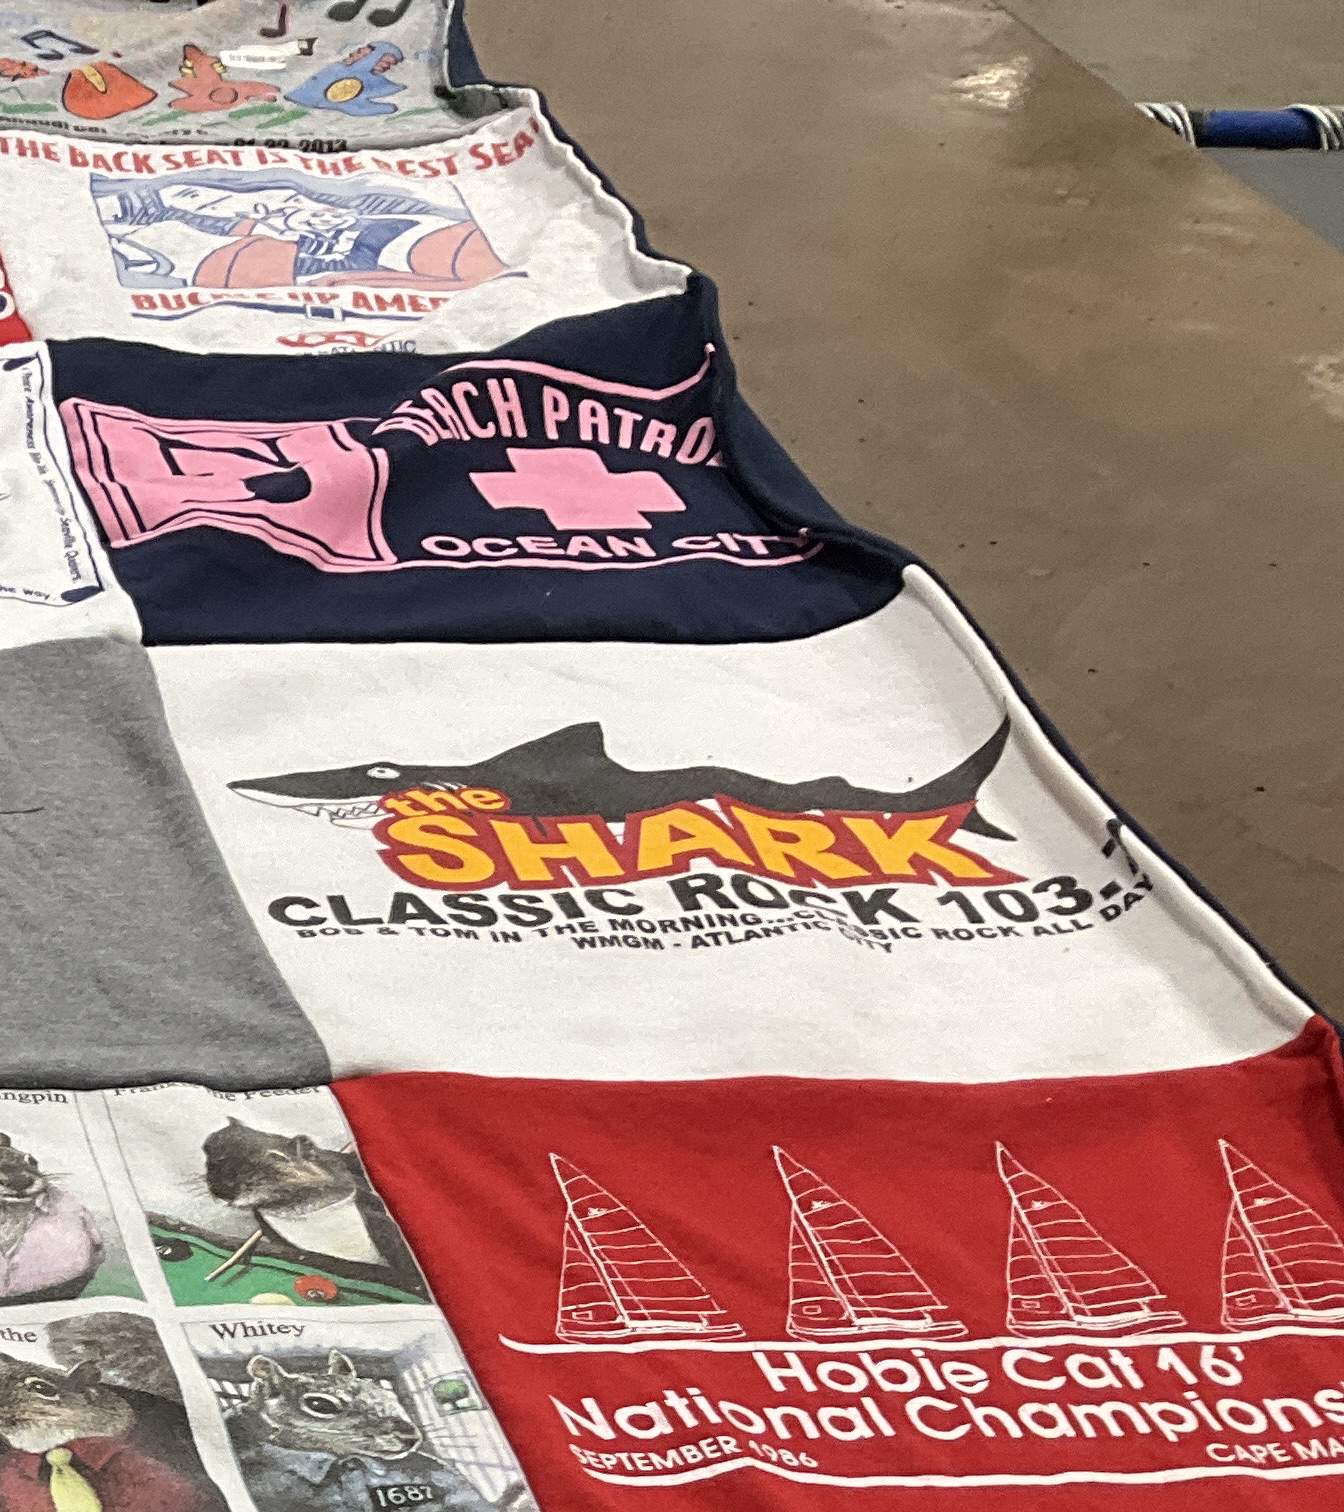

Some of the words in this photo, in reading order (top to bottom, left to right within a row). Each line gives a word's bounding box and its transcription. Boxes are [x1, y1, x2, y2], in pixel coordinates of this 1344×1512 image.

[67, 143, 157, 175] BACK
[161, 148, 244, 172] SEAT
[468, 118, 541, 171] SEA
[371, 377, 528, 447] BEACH
[542, 384, 725, 467] PATRO
[420, 534, 656, 558] OCEAN
[384, 786, 509, 818] the
[383, 802, 997, 886] SHARK
[267, 887, 644, 928] CLASSIC
[666, 872, 921, 926] ROCK
[295, 926, 366, 939] BOB
[408, 926, 481, 941] TOM
[490, 930, 523, 943] IN
[532, 920, 600, 938] THE
[931, 925, 1024, 942] ROCK
[1032, 919, 1094, 937] ALL
[1098, 873, 1154, 922] DAY
[570, 936, 664, 951] WMGM
[689, 921, 832, 950] ATLANTIC
[209, 1321, 308, 1341] Whitey
[753, 1347, 991, 1396] Hobie
[1001, 1348, 1145, 1391] Cat
[548, 1387, 898, 1441] National
[904, 1388, 1344, 1443] Champions
[568, 1434, 745, 1473] SEPTEMBER
[746, 1439, 820, 1469] 1986
[1205, 1441, 1294, 1465] CAPE
[1290, 1436, 1344, 1462] MA
[373, 1484, 436, 1508] 1687
